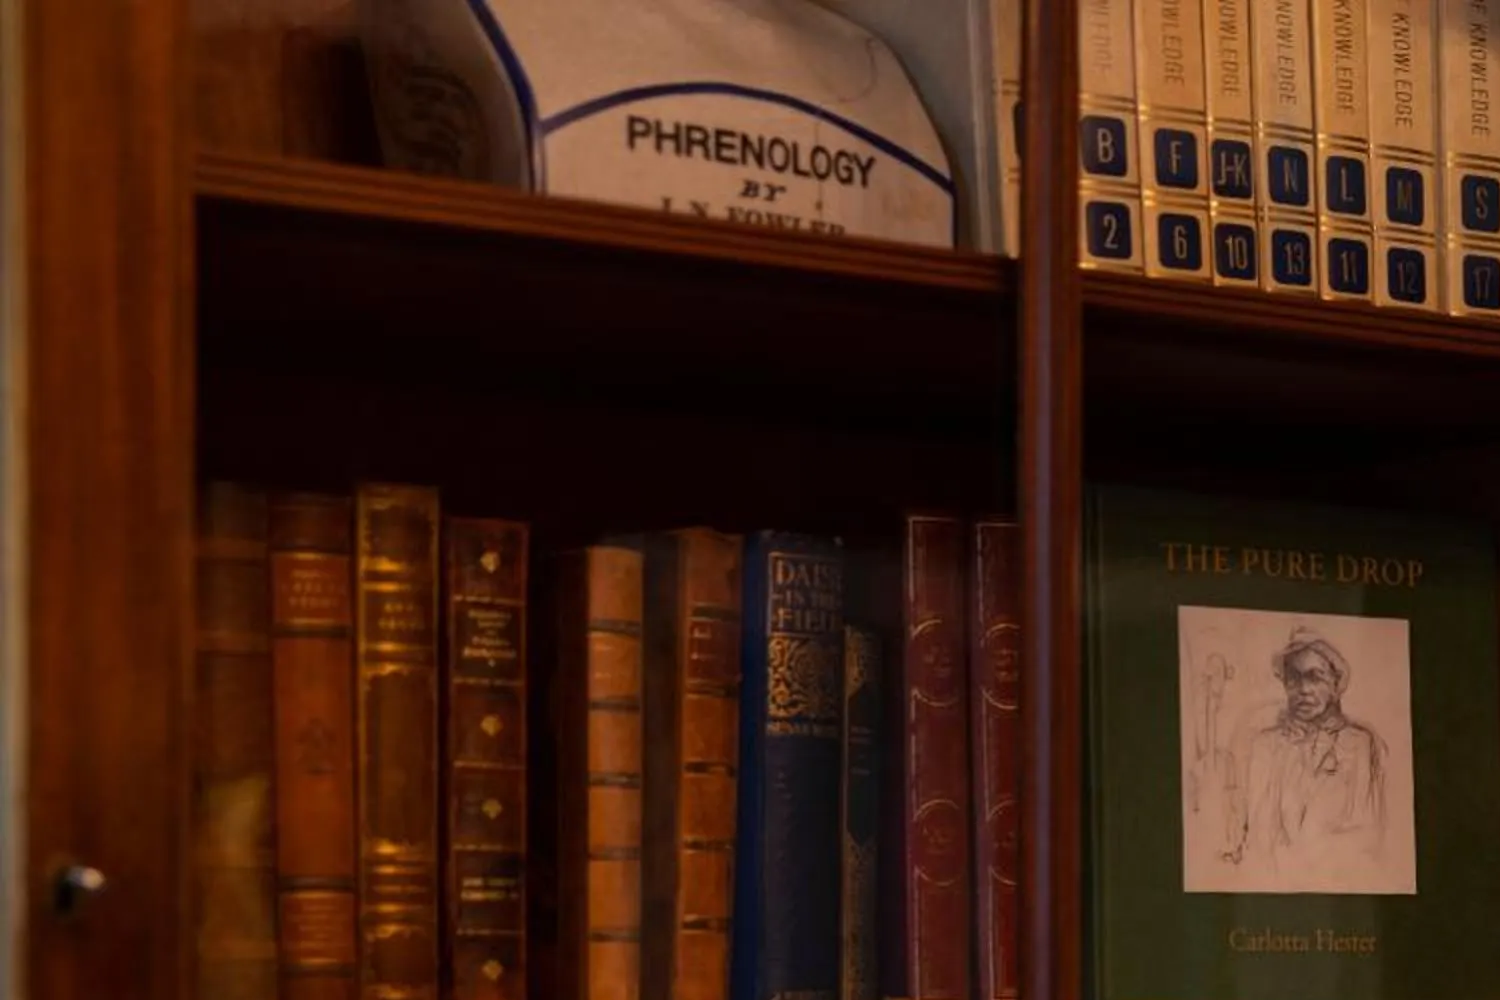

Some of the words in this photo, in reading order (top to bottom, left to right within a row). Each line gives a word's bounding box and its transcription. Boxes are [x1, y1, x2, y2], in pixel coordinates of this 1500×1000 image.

[1392, 12, 1414, 129] KNOWLEDGE
[1469, 22, 1491, 137] KNOWLEDGE
[627, 115, 877, 189] PHRENOLOGY
[1097, 128, 1114, 163] B
[1170, 141, 1183, 175] F
[1217, 151, 1249, 186] J-K
[1284, 158, 1299, 193] N
[1340, 166, 1354, 202] L
[739, 180, 787, 202] BY
[1396, 180, 1414, 215] M
[1475, 185, 1489, 220] S
[1103, 214, 1118, 249] 2
[1173, 225, 1188, 259] 6
[1225, 235, 1248, 269] 10
[1284, 242, 1305, 275] 13
[1340, 250, 1358, 285] 11
[1397, 260, 1418, 294] 12
[1474, 265, 1492, 300] 17
[1160, 543, 1232, 574] THE
[1241, 546, 1327, 580] PURE
[1336, 553, 1424, 587] DROP
[1229, 926, 1309, 953] Carlotta
